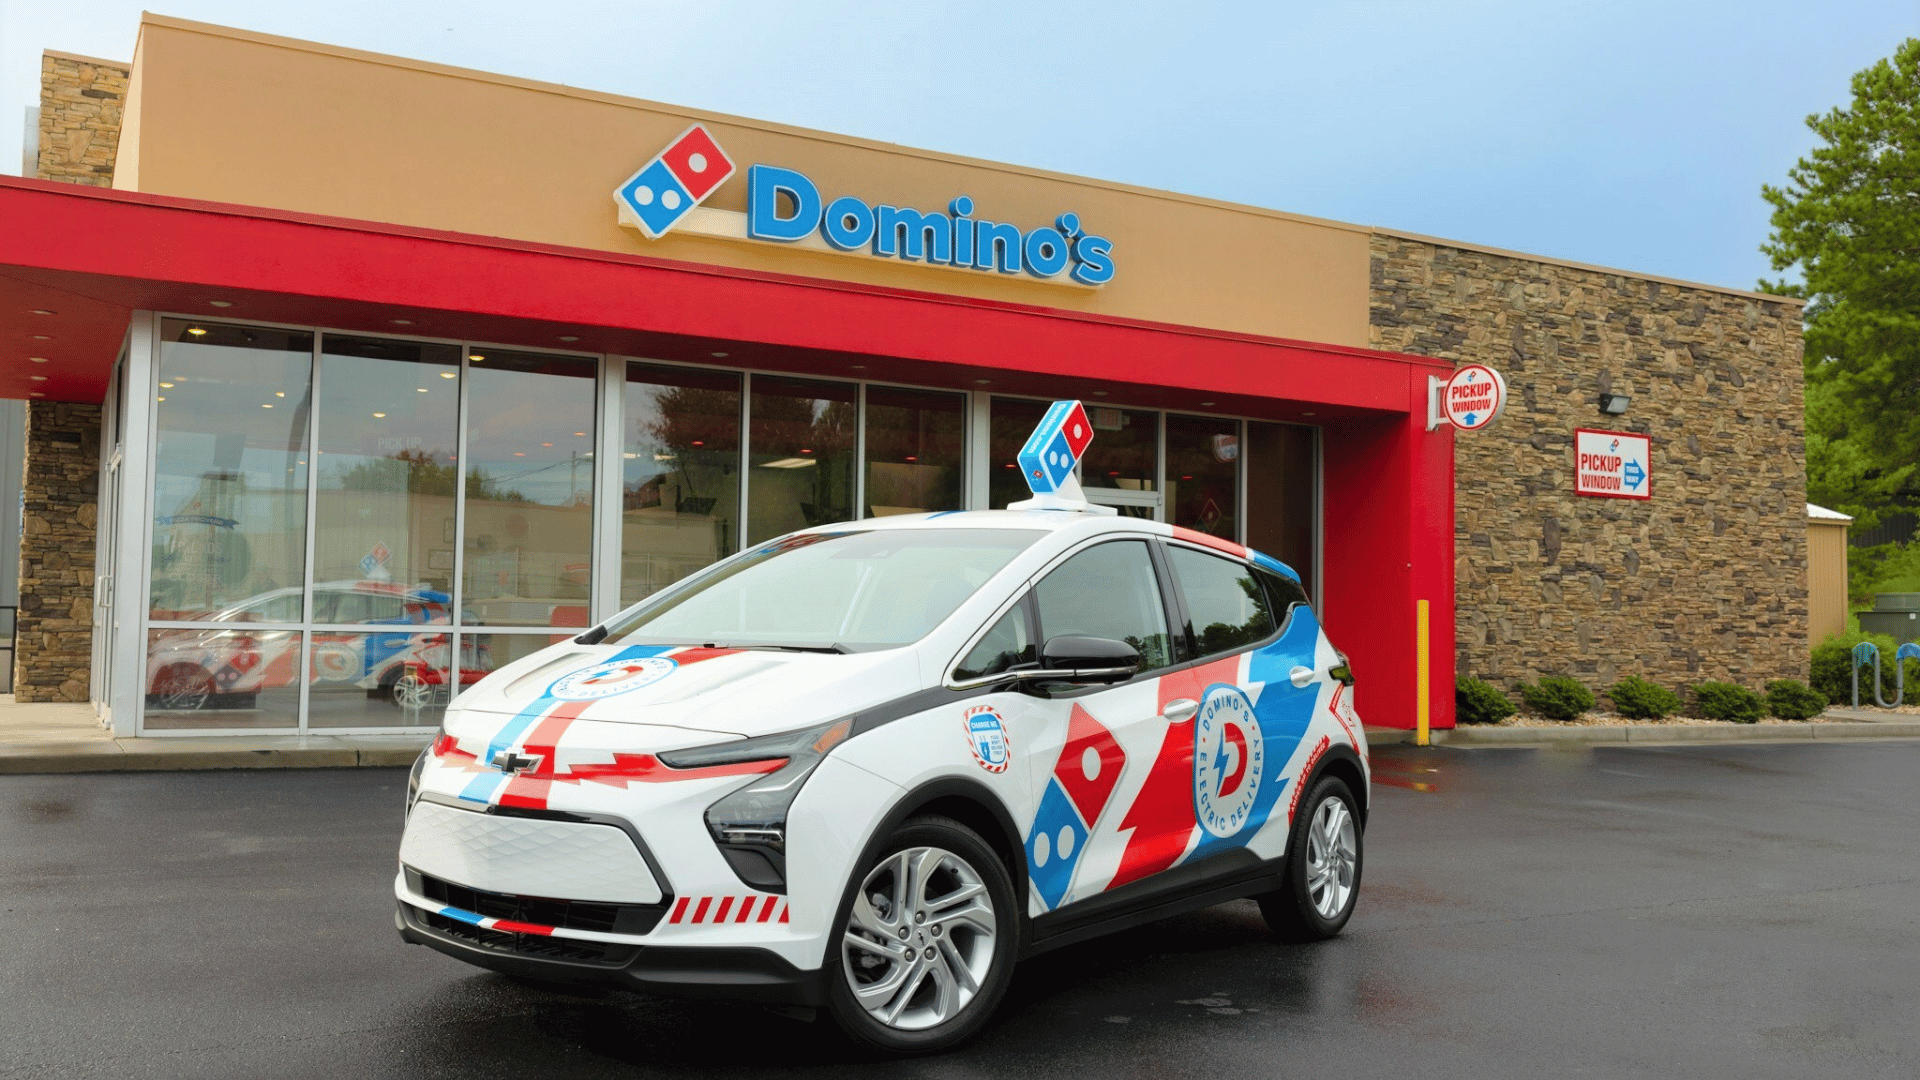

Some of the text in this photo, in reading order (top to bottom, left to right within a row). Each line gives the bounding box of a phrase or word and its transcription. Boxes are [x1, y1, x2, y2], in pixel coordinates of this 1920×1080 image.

[747, 163, 1116, 285] Domino's
[1452, 383, 1492, 399] PICKUP
[1452, 398, 1491, 413] WINDOW
[1580, 453, 1622, 473] PICKUP
[1581, 474, 1622, 490] WINDOW
[1203, 695, 1249, 731] DOMINO'S
[1199, 738, 1261, 831] ELECTRIC DELIVERY
